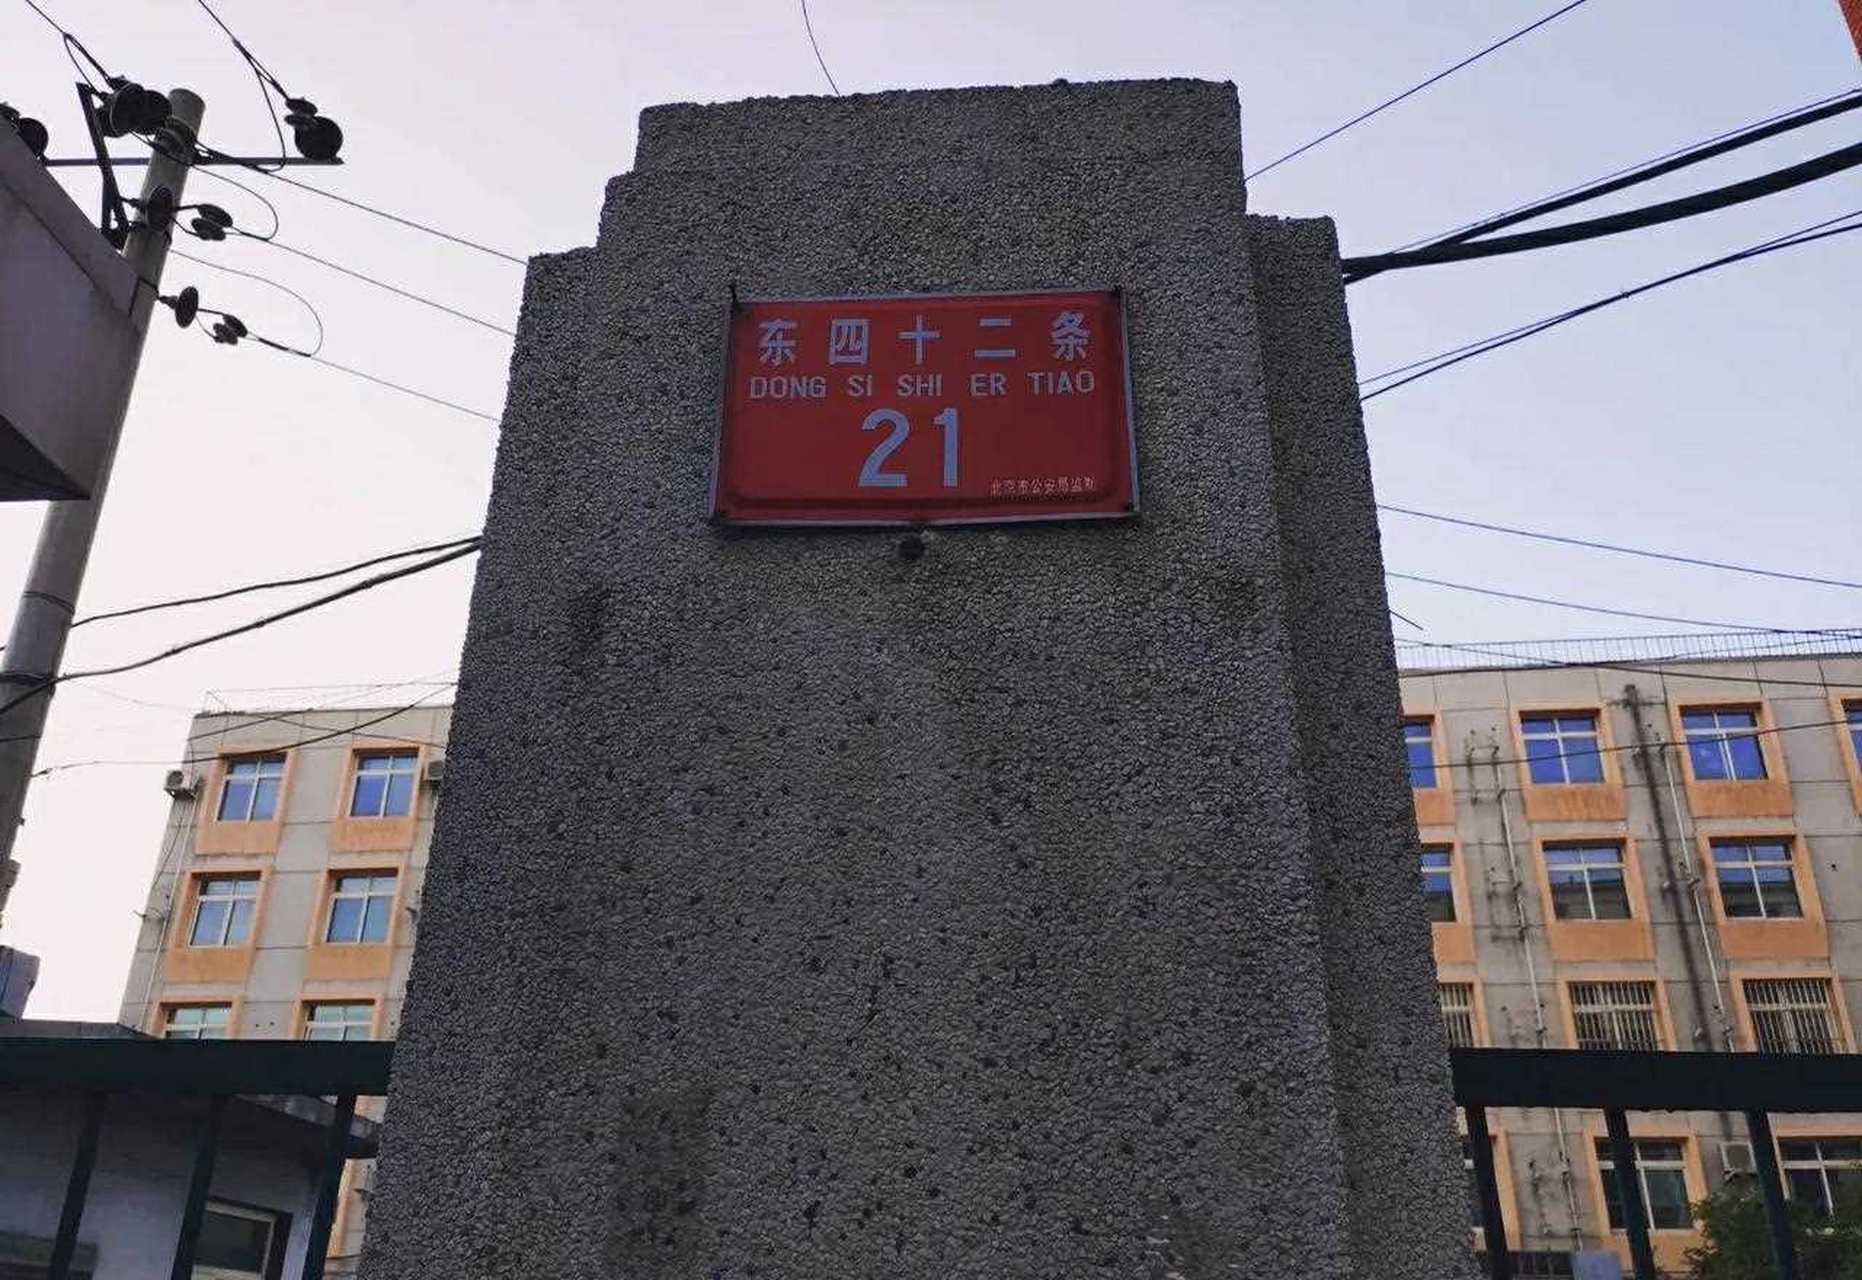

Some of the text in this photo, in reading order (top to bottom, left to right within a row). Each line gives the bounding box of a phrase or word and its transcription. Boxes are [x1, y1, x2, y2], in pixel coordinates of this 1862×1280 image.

[757, 310, 1090, 366] 东四十二条
[749, 370, 1096, 399] DONG SI SHI ER TIAO
[857, 407, 961, 488] 21
